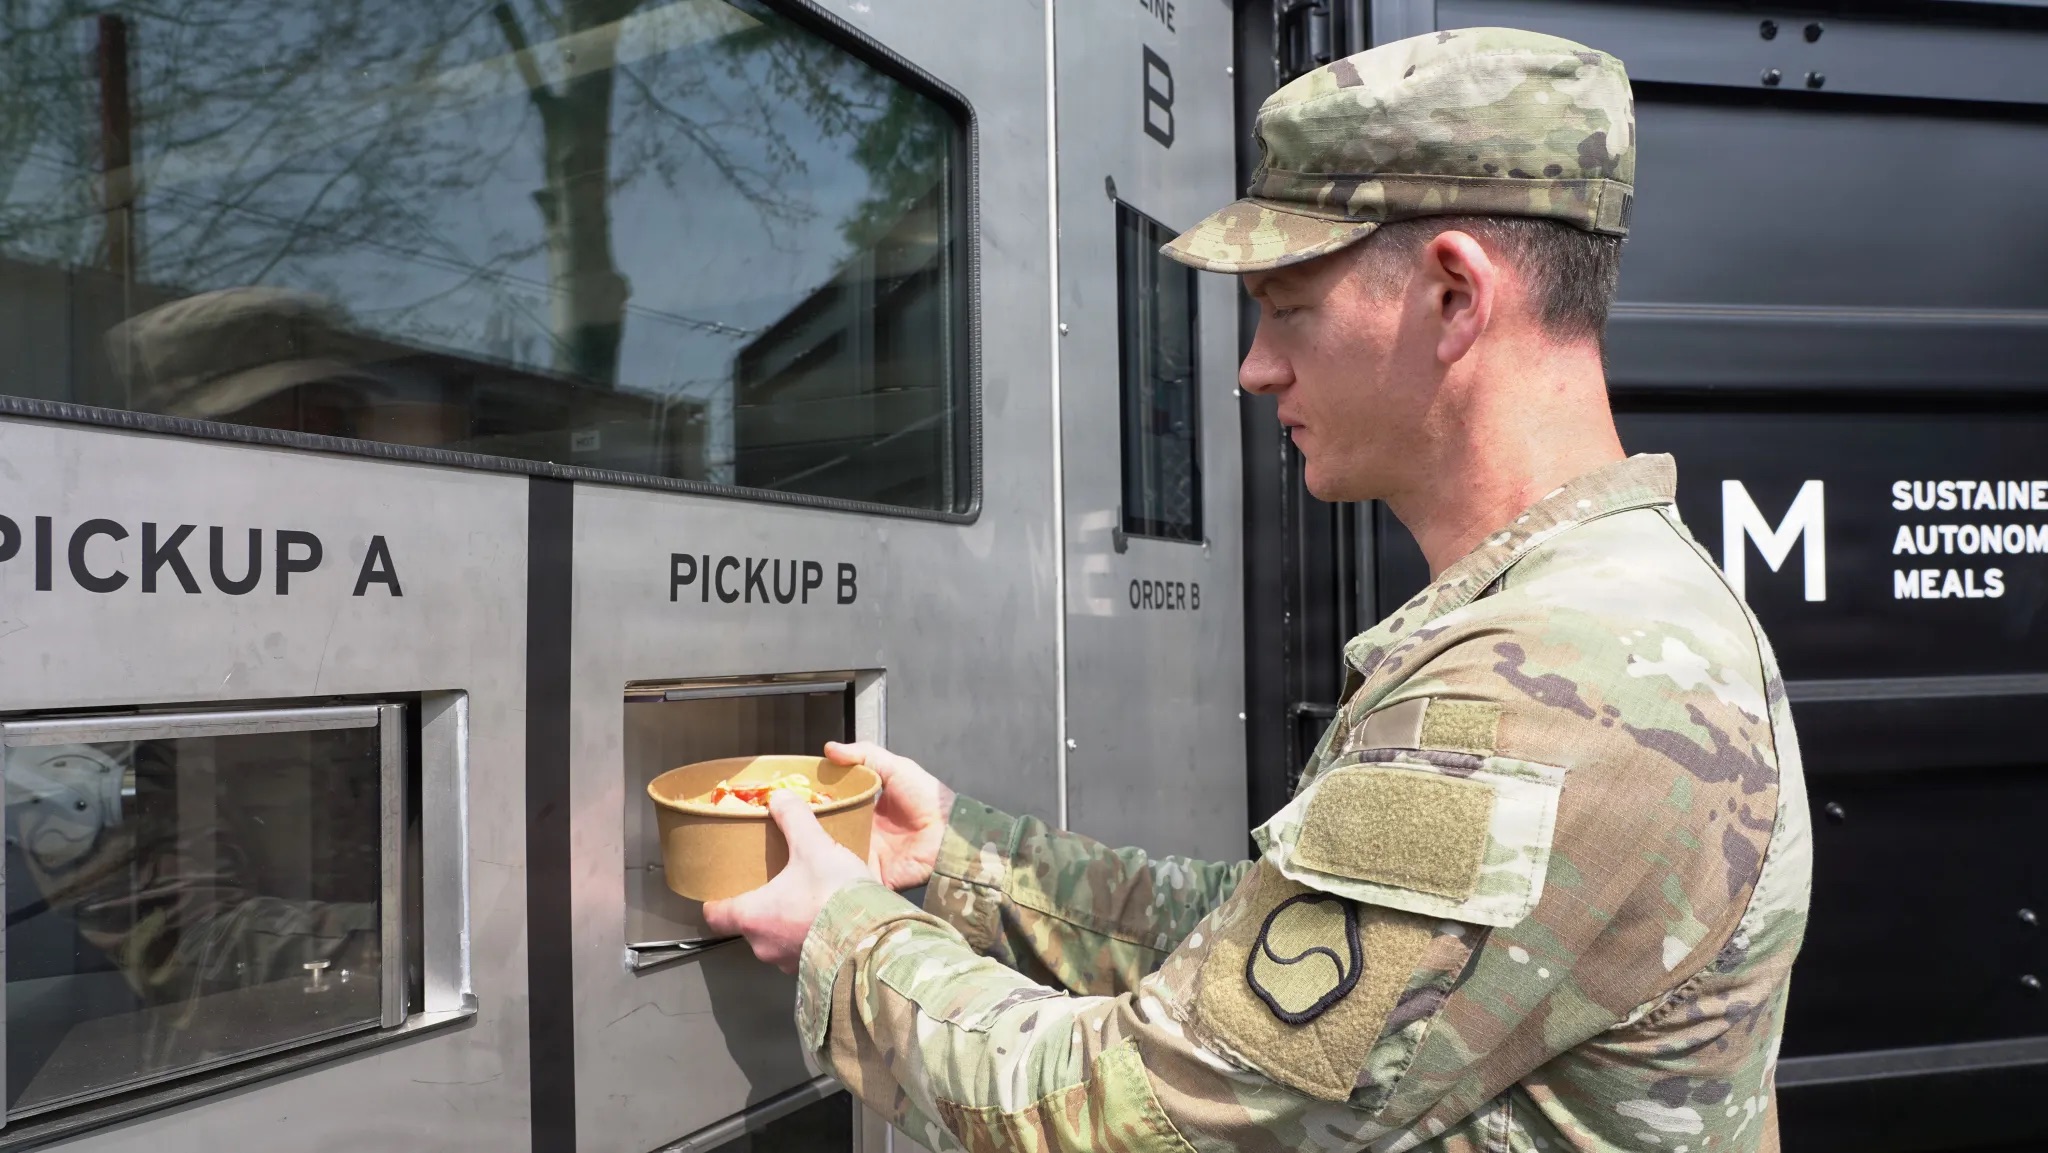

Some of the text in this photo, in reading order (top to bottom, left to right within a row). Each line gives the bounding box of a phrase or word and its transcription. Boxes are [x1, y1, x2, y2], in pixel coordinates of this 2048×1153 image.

[1139, 0, 1176, 34] INE
[1143, 43, 1174, 149] B
[1892, 480, 2048, 511] SUSTAINE
[1721, 479, 1826, 601] M
[1892, 524, 2048, 555] AUTONOM
[352, 535, 403, 597] A
[670, 552, 858, 605] PICKUP B
[1129, 579, 1201, 610] ORDER B
[1894, 568, 2006, 600] MEALS
